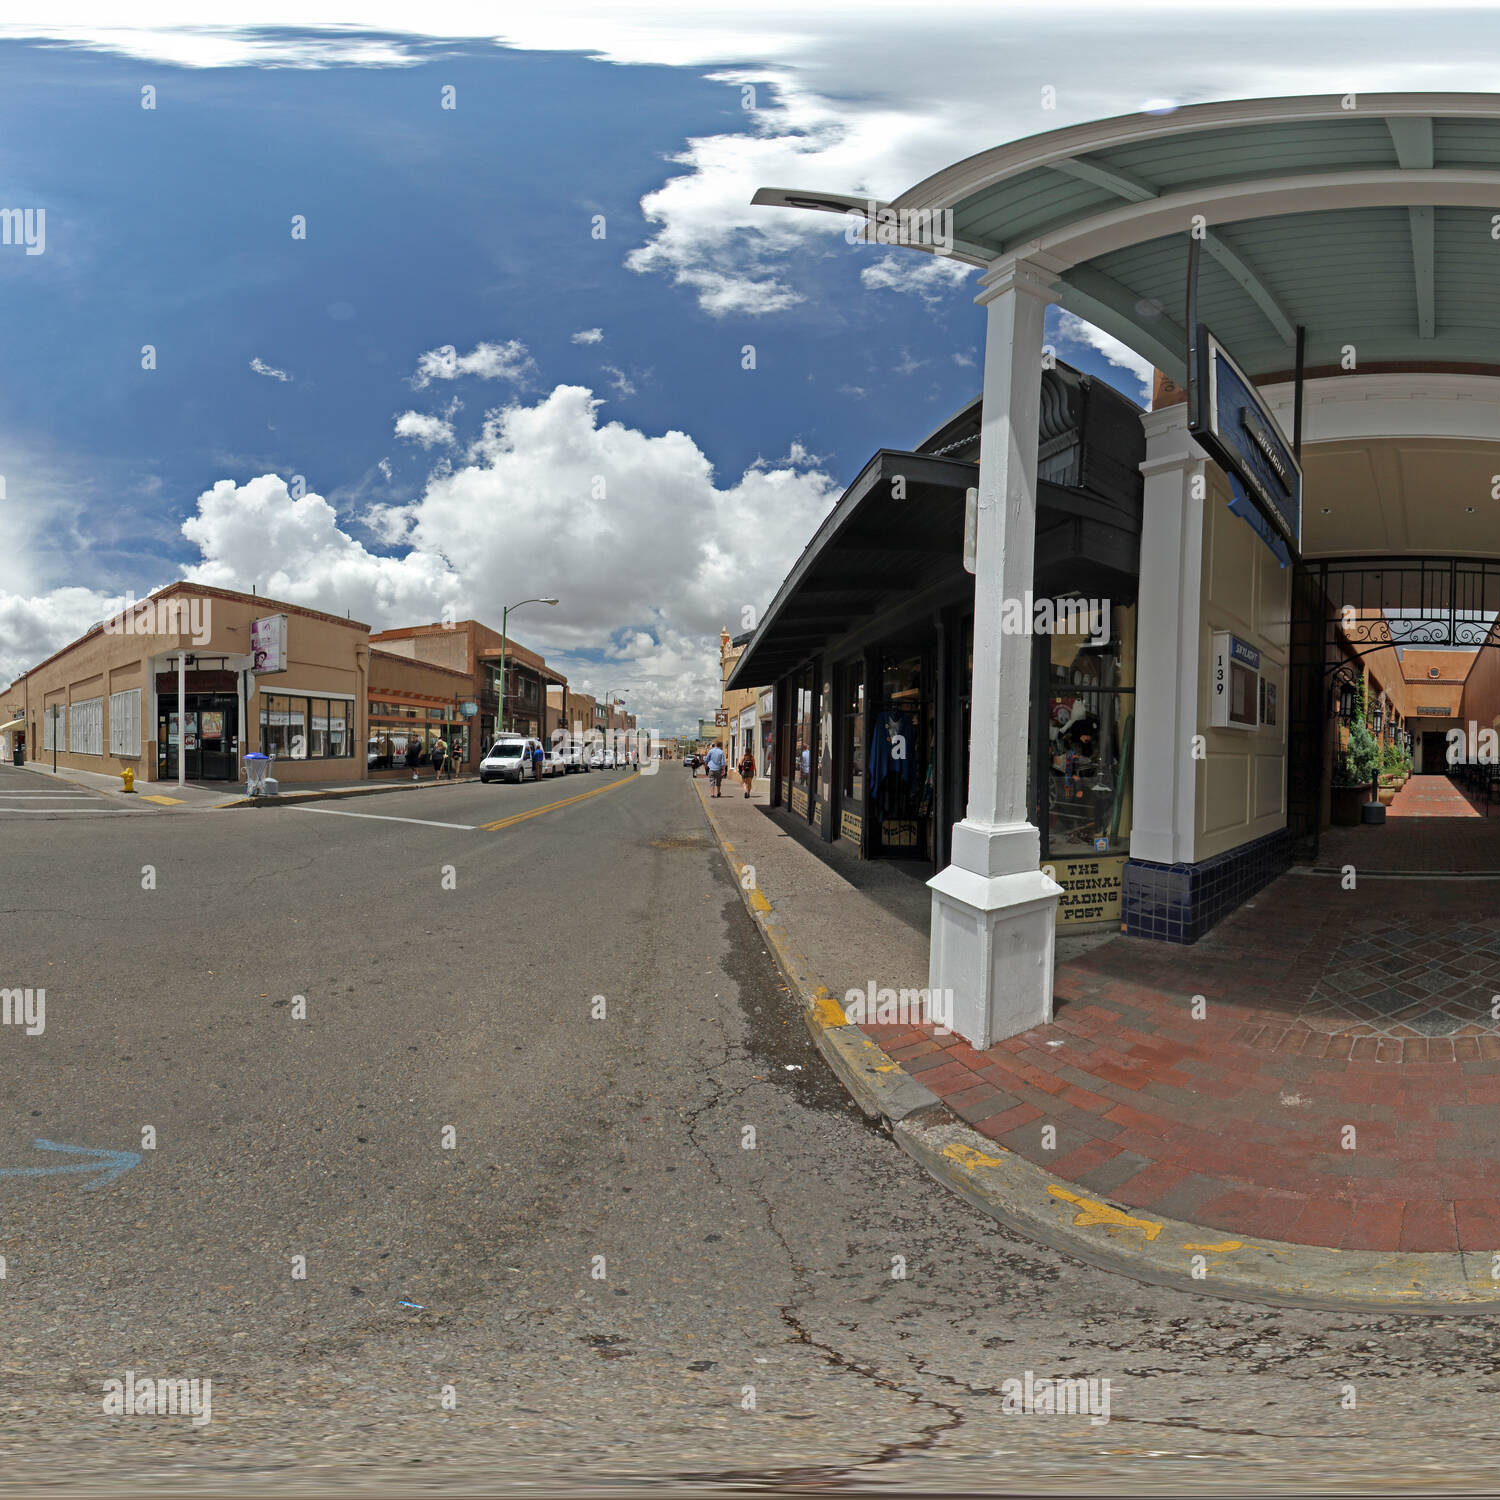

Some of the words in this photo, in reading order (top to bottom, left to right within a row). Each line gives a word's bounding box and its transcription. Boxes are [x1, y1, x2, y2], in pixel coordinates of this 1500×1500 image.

[1258, 432, 1285, 477] SKYLIGHT
[1236, 643, 1258, 665] SKYLIGHT
[1216, 655, 1224, 695] 139
[1067, 863, 1099, 876] THE
[1057, 876, 1121, 891] RIGINAL
[1059, 891, 1118, 906] RADING
[1064, 906, 1104, 920] POST
